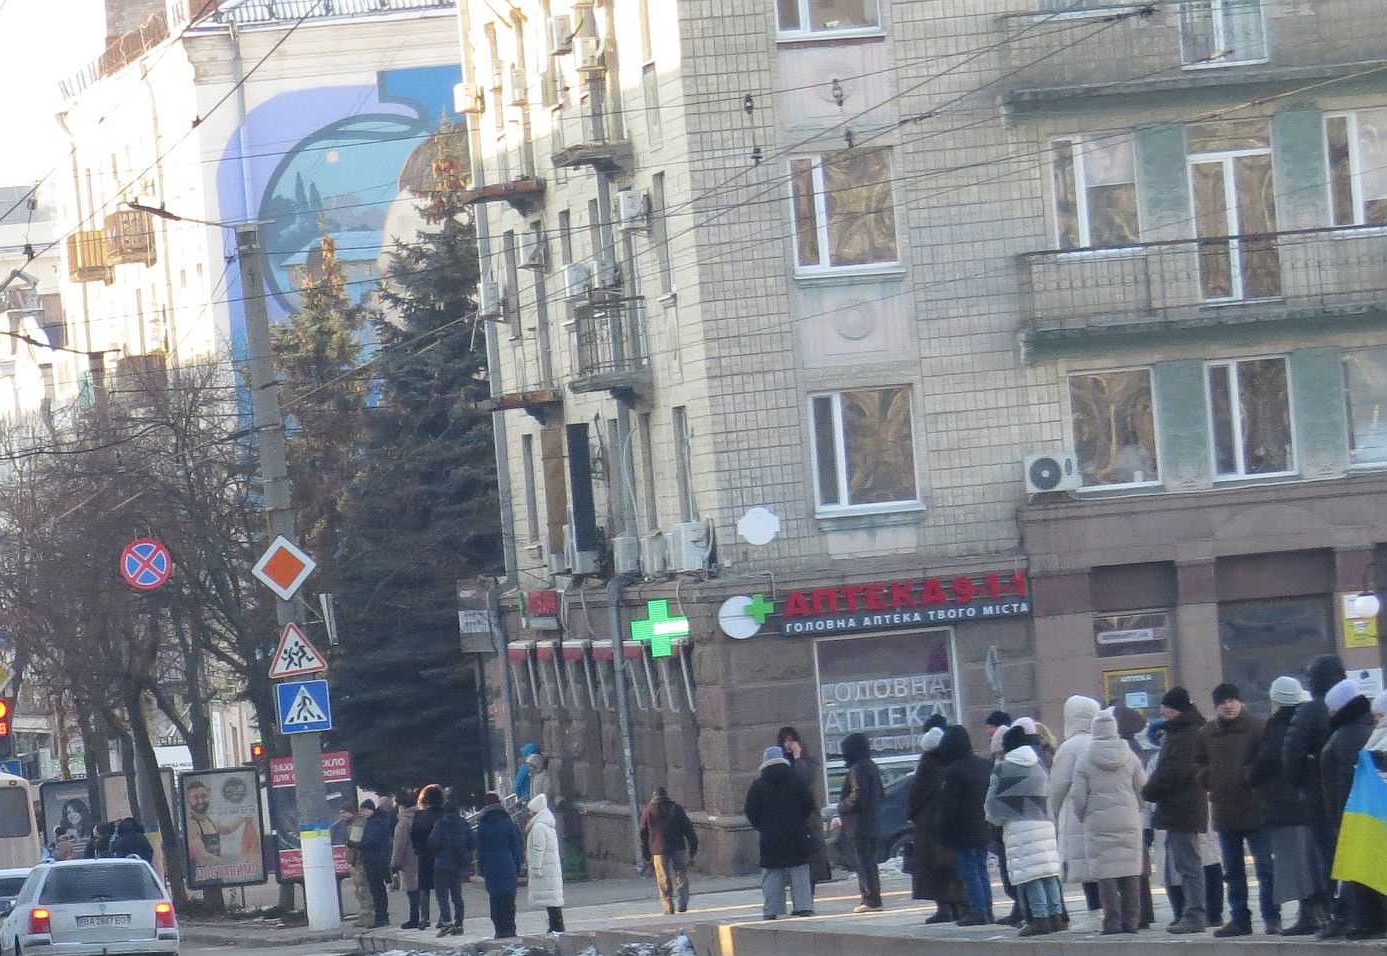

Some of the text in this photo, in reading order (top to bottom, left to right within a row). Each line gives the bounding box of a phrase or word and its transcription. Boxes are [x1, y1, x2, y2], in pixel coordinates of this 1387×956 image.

[783, 577, 948, 619] АПТЕКА
[785, 602, 1029, 634] ГОЛОВНА АПТЕКА ТВОГО МІСТА
